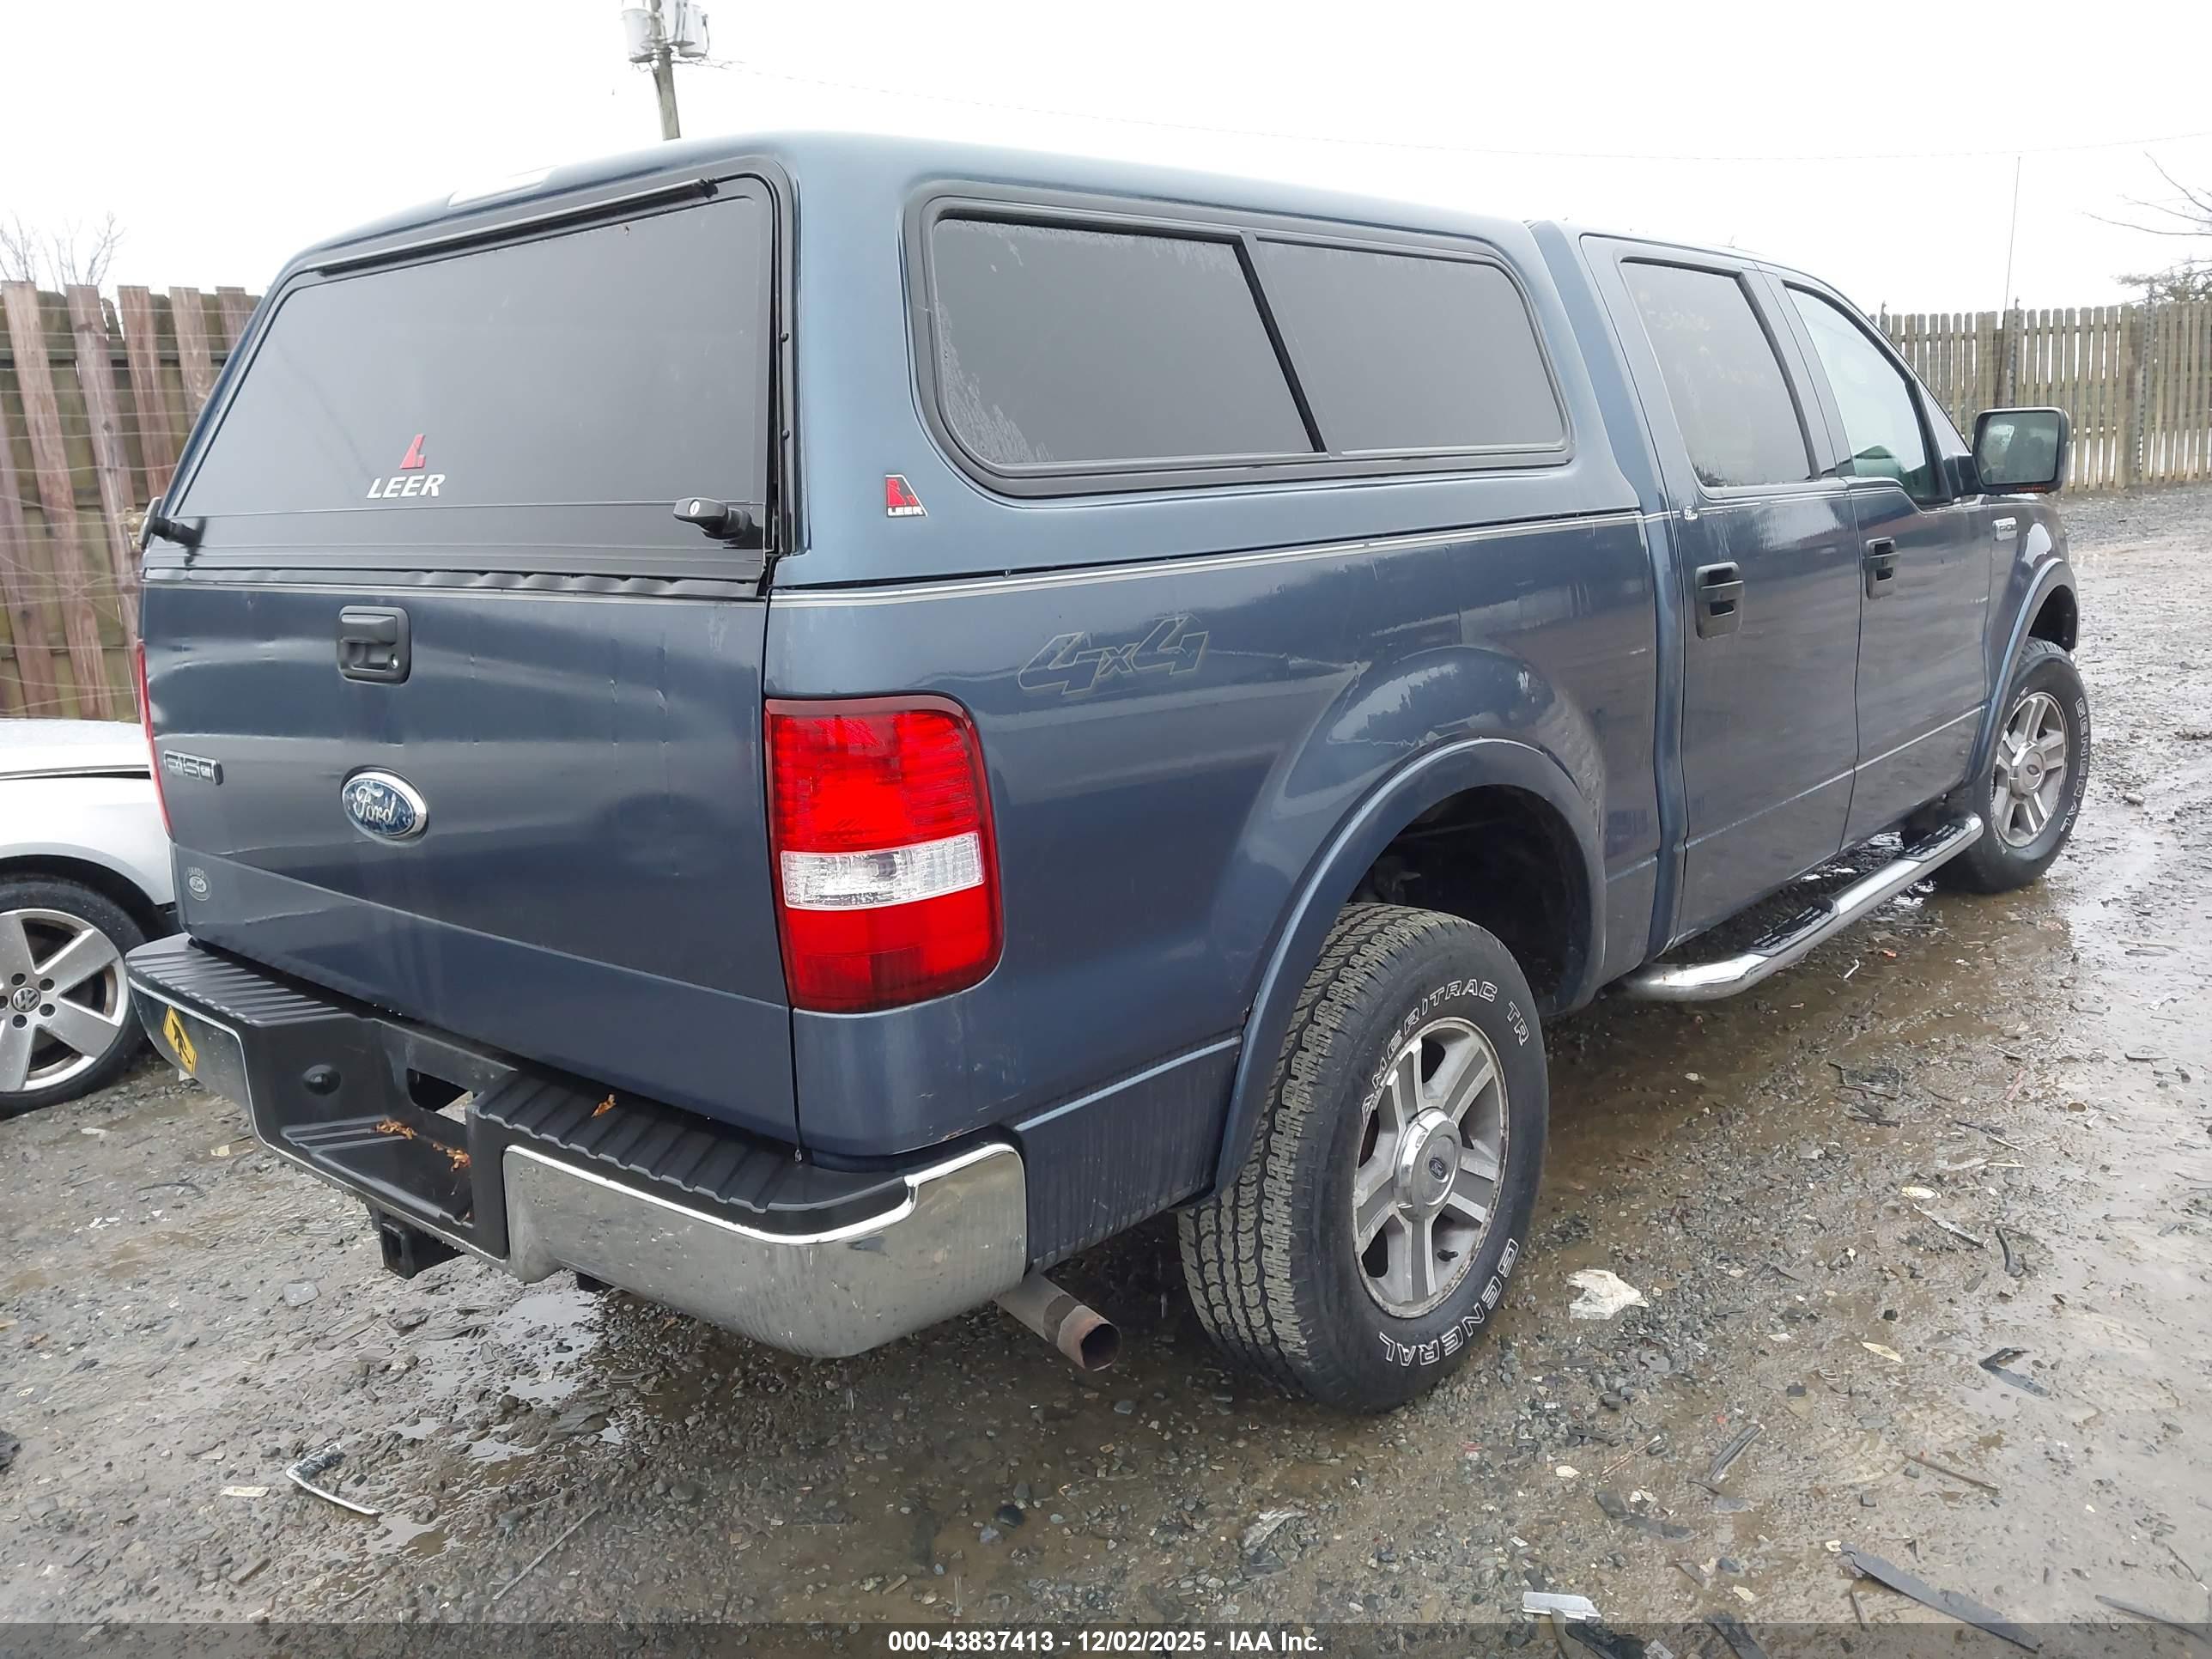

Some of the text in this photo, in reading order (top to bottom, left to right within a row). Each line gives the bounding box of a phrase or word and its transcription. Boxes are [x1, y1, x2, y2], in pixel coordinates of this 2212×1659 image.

[366, 473, 446, 499] LEER
[887, 506, 924, 516] LEER
[353, 785, 398, 824] Ford
[1361, 978, 1531, 1126] AMERITRAC TR
[1378, 1237, 1520, 1367] GENERAL
